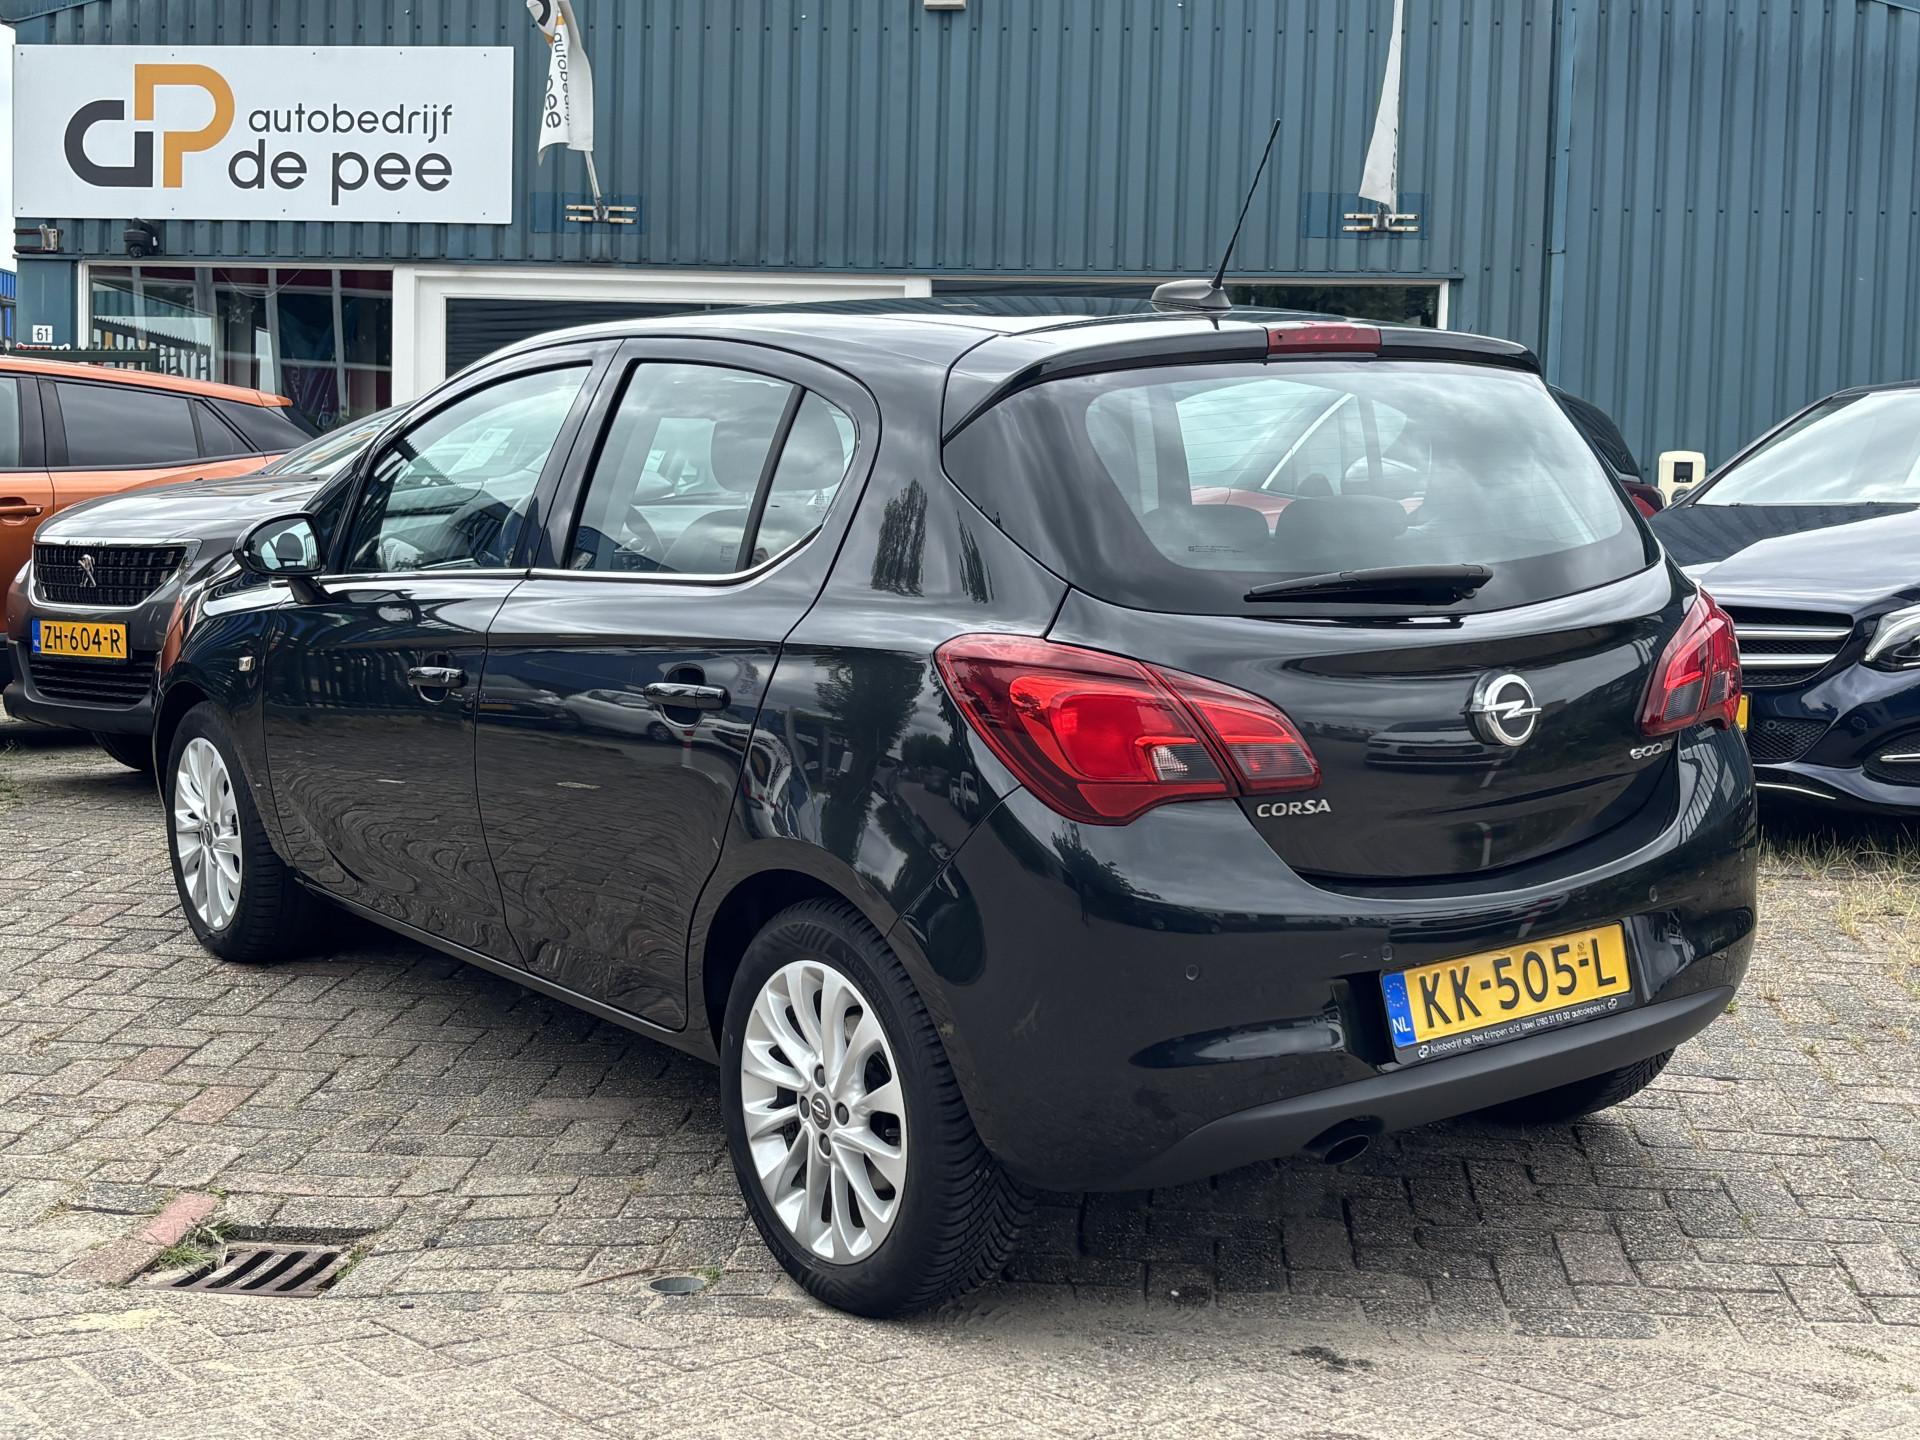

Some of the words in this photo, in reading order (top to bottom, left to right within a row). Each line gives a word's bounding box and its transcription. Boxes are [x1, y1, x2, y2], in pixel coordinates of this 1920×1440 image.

[248, 103, 453, 144] autobedrijf
[228, 139, 307, 190] de
[331, 152, 453, 206] pee
[37, 328, 49, 341] 61
[44, 625, 122, 653] ZH-604-R
[1256, 799, 1332, 817] CORSA
[1419, 938, 1617, 1028] KK-505-L
[1392, 1018, 1411, 1034] NL
[1430, 1038, 1462, 1054] Autobedrijf
[1463, 1037, 1472, 1045] de
[1472, 1033, 1484, 1043] Pee
[1484, 1028, 1508, 1040] Krimpen
[1508, 1024, 1520, 1034] a/d
[1562, 1011, 1570, 1021] 00
